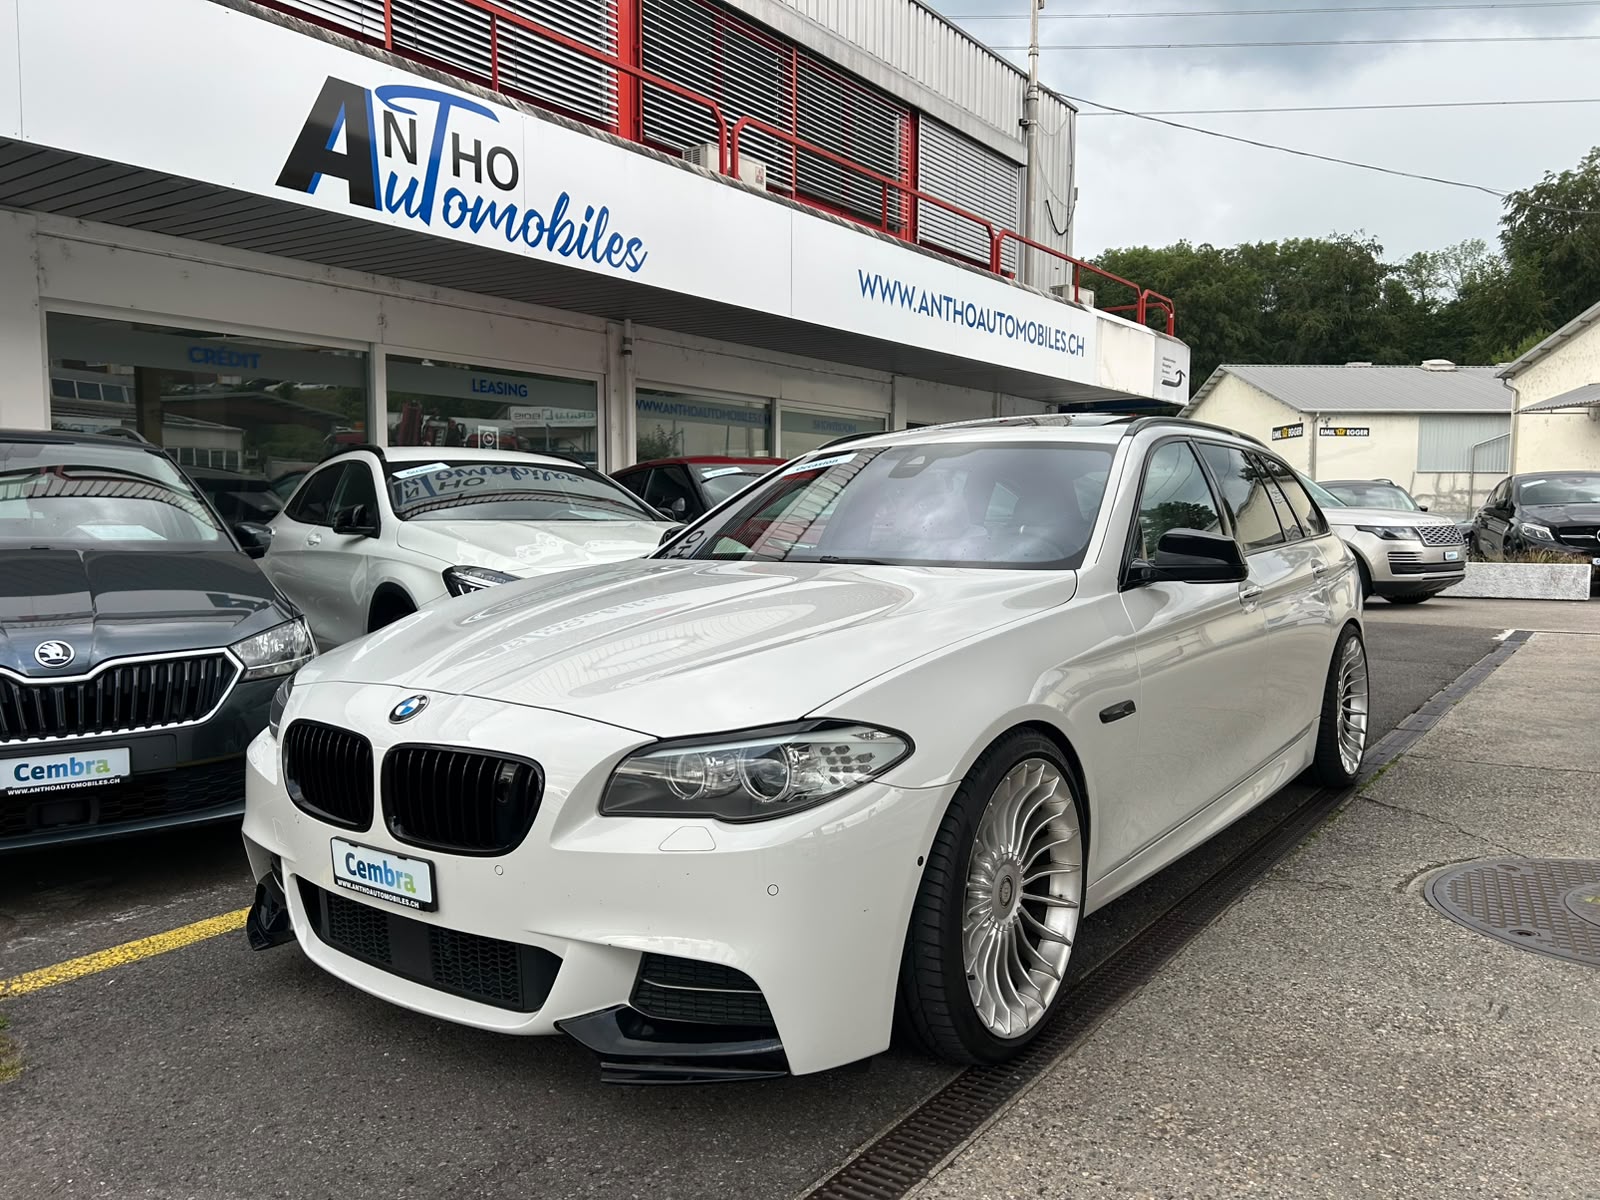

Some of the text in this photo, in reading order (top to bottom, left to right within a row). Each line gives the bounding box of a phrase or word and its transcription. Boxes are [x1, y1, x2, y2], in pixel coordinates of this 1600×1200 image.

[858, 269, 1085, 357] WWW.ANTHOAUTOMOBILES.CH
[188, 346, 261, 369] CRÉDIT
[472, 378, 528, 397] LEASING
[13, 757, 110, 782] Cembra
[7, 778, 120, 796] WWW.ANTHOAUTOMOBILES.CH
[345, 852, 416, 894] Cembra
[337, 879, 420, 908] WWW.ANTHOAUTOMOBILES.CH
